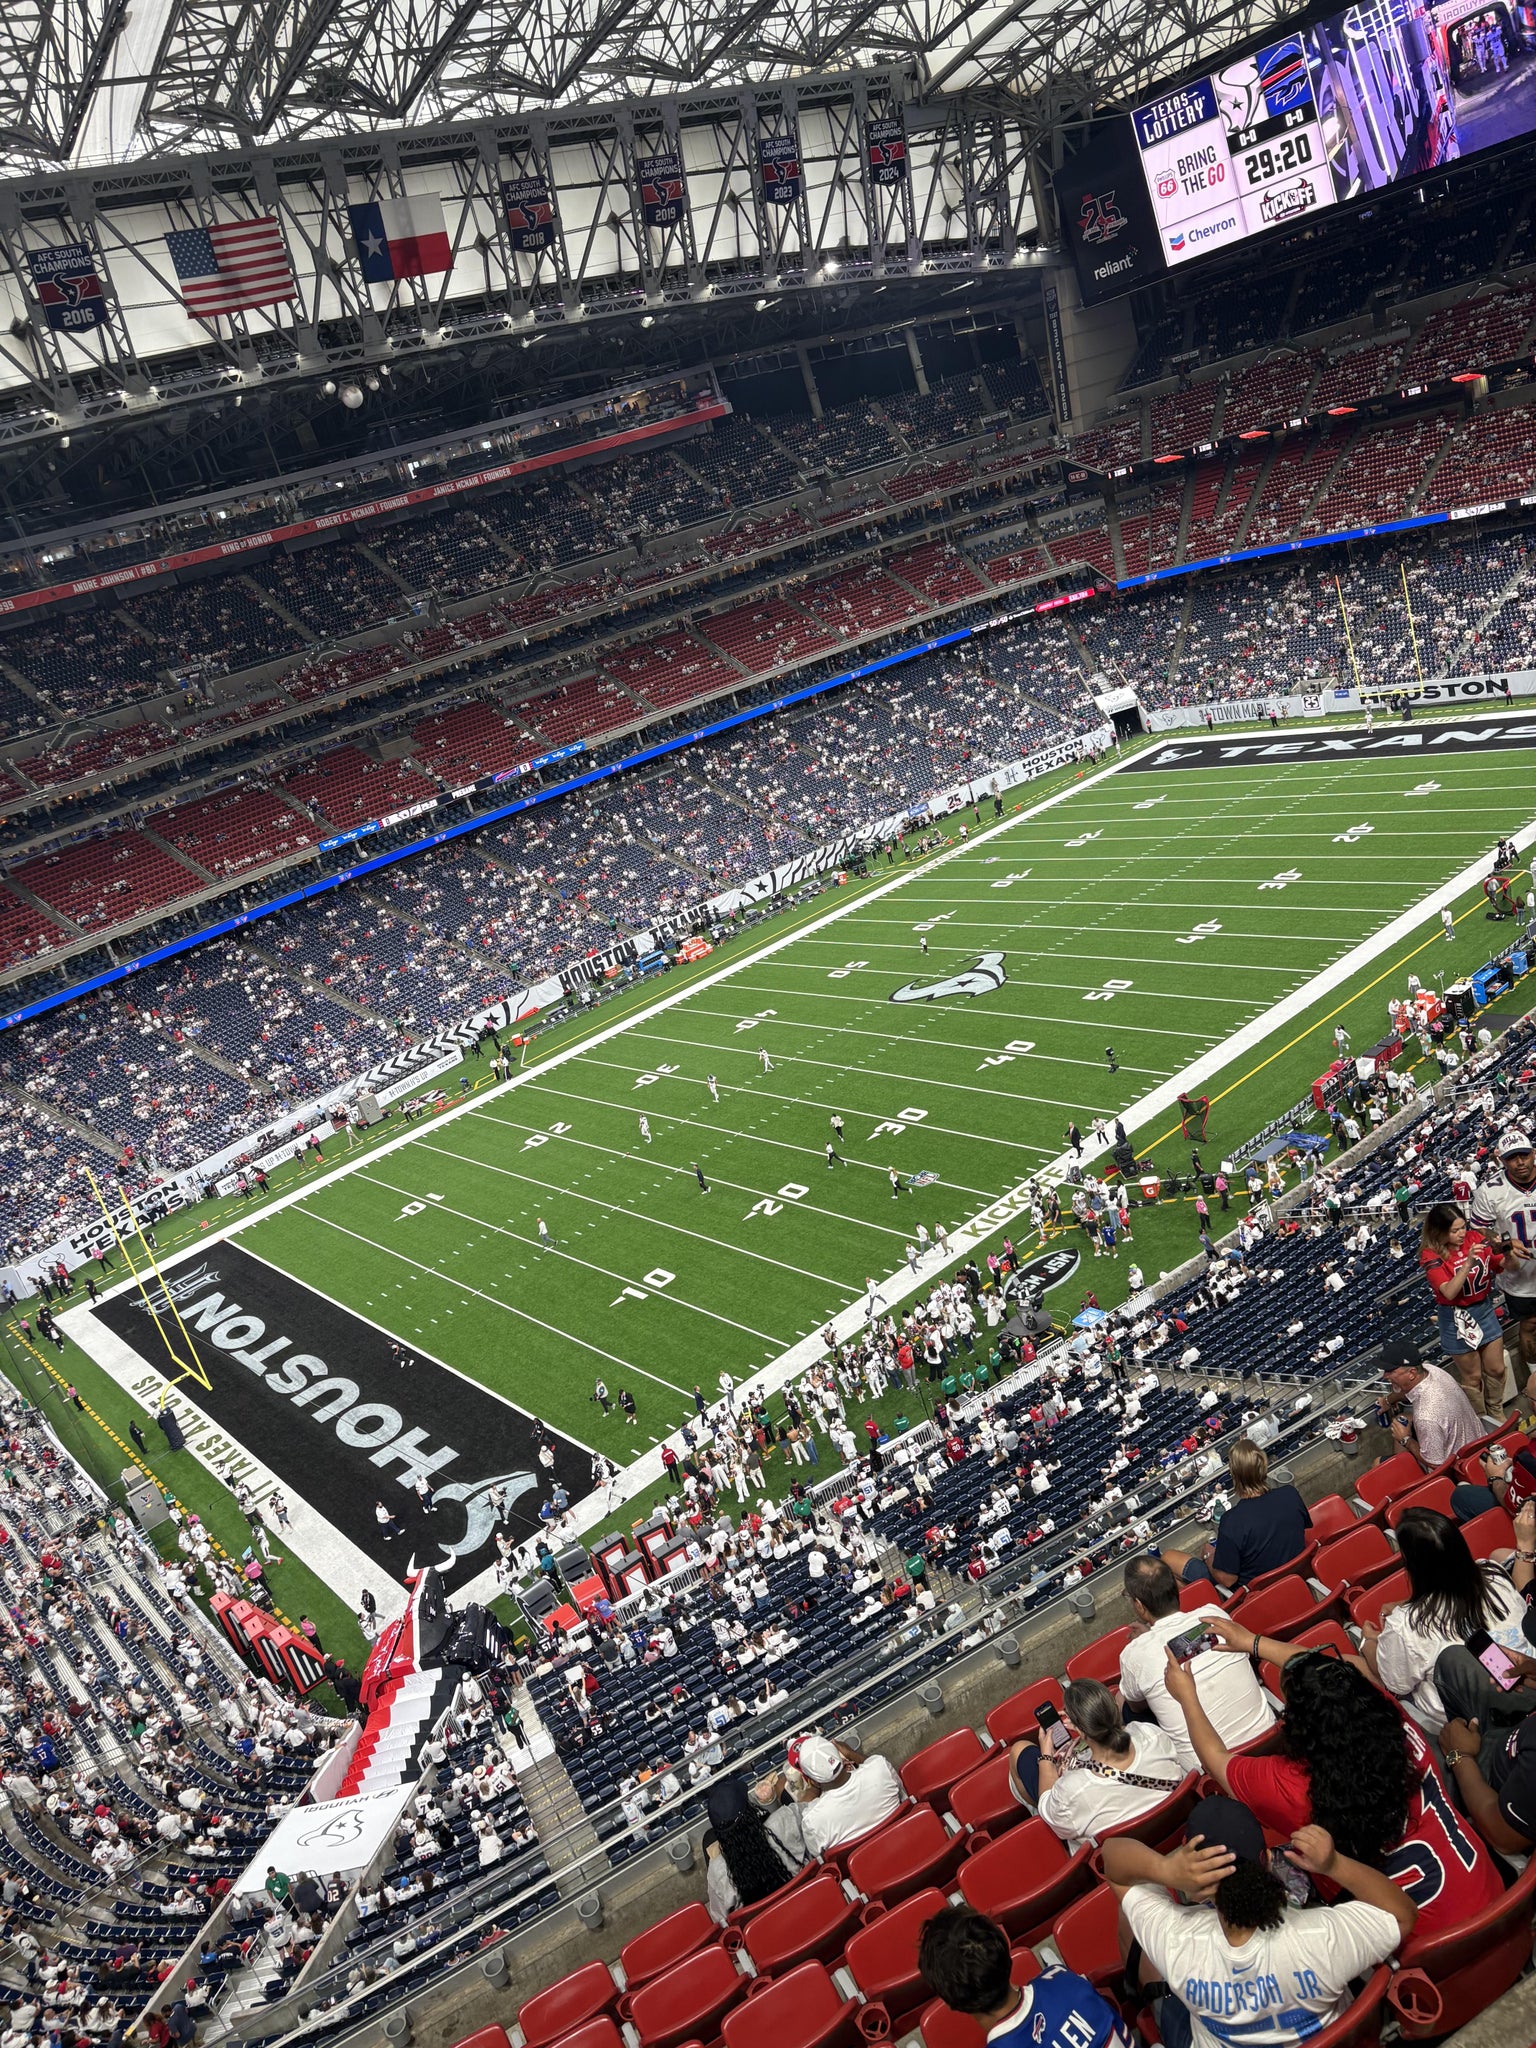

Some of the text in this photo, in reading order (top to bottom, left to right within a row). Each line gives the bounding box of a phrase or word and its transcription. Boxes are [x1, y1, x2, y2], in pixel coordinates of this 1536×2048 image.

[1151, 92, 1189, 120] TEXAS
[1285, 109, 1304, 127] 0-0
[1143, 97, 1204, 143] LOTTERY
[1239, 129, 1257, 147] 0-0
[641, 164, 678, 178] CHAMPIONS
[644, 158, 673, 169] AFC SOUTH
[1177, 145, 1217, 176] BRING
[1245, 133, 1312, 185] 29:20
[509, 180, 541, 192] AFC SOUTH
[879, 166, 899, 182] 2024
[1181, 163, 1225, 196] THE GO
[506, 186, 546, 202] CHAMPIONS
[774, 185, 793, 200] 2023
[1160, 179, 1177, 197] 66
[655, 206, 676, 222] 2019
[1080, 190, 1122, 231] 25
[1260, 184, 1316, 221] KICKOFF
[522, 231, 545, 248] 2018
[1188, 217, 1237, 243] Chevron
[33, 255, 92, 274] CHAMPIONS
[37, 247, 83, 262] AFC SOUTH
[1094, 254, 1133, 280] reliant
[61, 307, 96, 327] 2016
[433, 467, 511, 496] JANICE MCNAIR FOUNDER
[316, 515, 343, 529] ROBERT
[352, 506, 376, 520] MCNAIR
[380, 496, 409, 513] FOUNDER
[221, 541, 240, 554] RING
[247, 533, 273, 547] HONOR
[73, 564, 156, 593] ANDRE JOHNSON #80
[1305, 696, 1319, 709] 25
[1360, 678, 1509, 704] HOUSTON
[1218, 724, 1536, 759] TEXANS
[1022, 739, 1083, 770] HOUSTON
[1024, 752, 1076, 778] TEXAN
[947, 794, 962, 809] 25
[1404, 782, 1442, 797] 10
[1331, 825, 1375, 843] 20
[1257, 871, 1303, 890] 30
[1175, 922, 1223, 944] 40
[557, 939, 638, 991] HOUSTON
[827, 960, 869, 979] 50
[1082, 979, 1134, 1001] 50
[735, 1008, 778, 1030] 40
[982, 1039, 1036, 1070] 40
[636, 1062, 680, 1087] 30
[874, 1106, 929, 1137] 30
[524, 1121, 573, 1148] 20
[1501, 1135, 1524, 1148] BILLS
[400, 1192, 446, 1217] 10
[750, 1181, 810, 1218] 20
[961, 1166, 1065, 1239] KICKOFF
[69, 1181, 180, 1250] HOUSTON
[76, 1194, 184, 1259] TEXAS
[618, 1267, 677, 1302] 10
[131, 1375, 163, 1398] US
[179, 1292, 460, 1489] HOUSTON
[177, 1407, 210, 1438] ALL
[196, 1434, 257, 1484] TAKES
[250, 1480, 280, 1505] IT
[590, 1723, 603, 1736] 55
[715, 1713, 728, 1727] 51
[304, 1795, 370, 1813] HYUNDAI
[327, 1889, 340, 1902] 02
[360, 1905, 369, 1918] 7
[1186, 1969, 1322, 2016] ANDERSON JR
